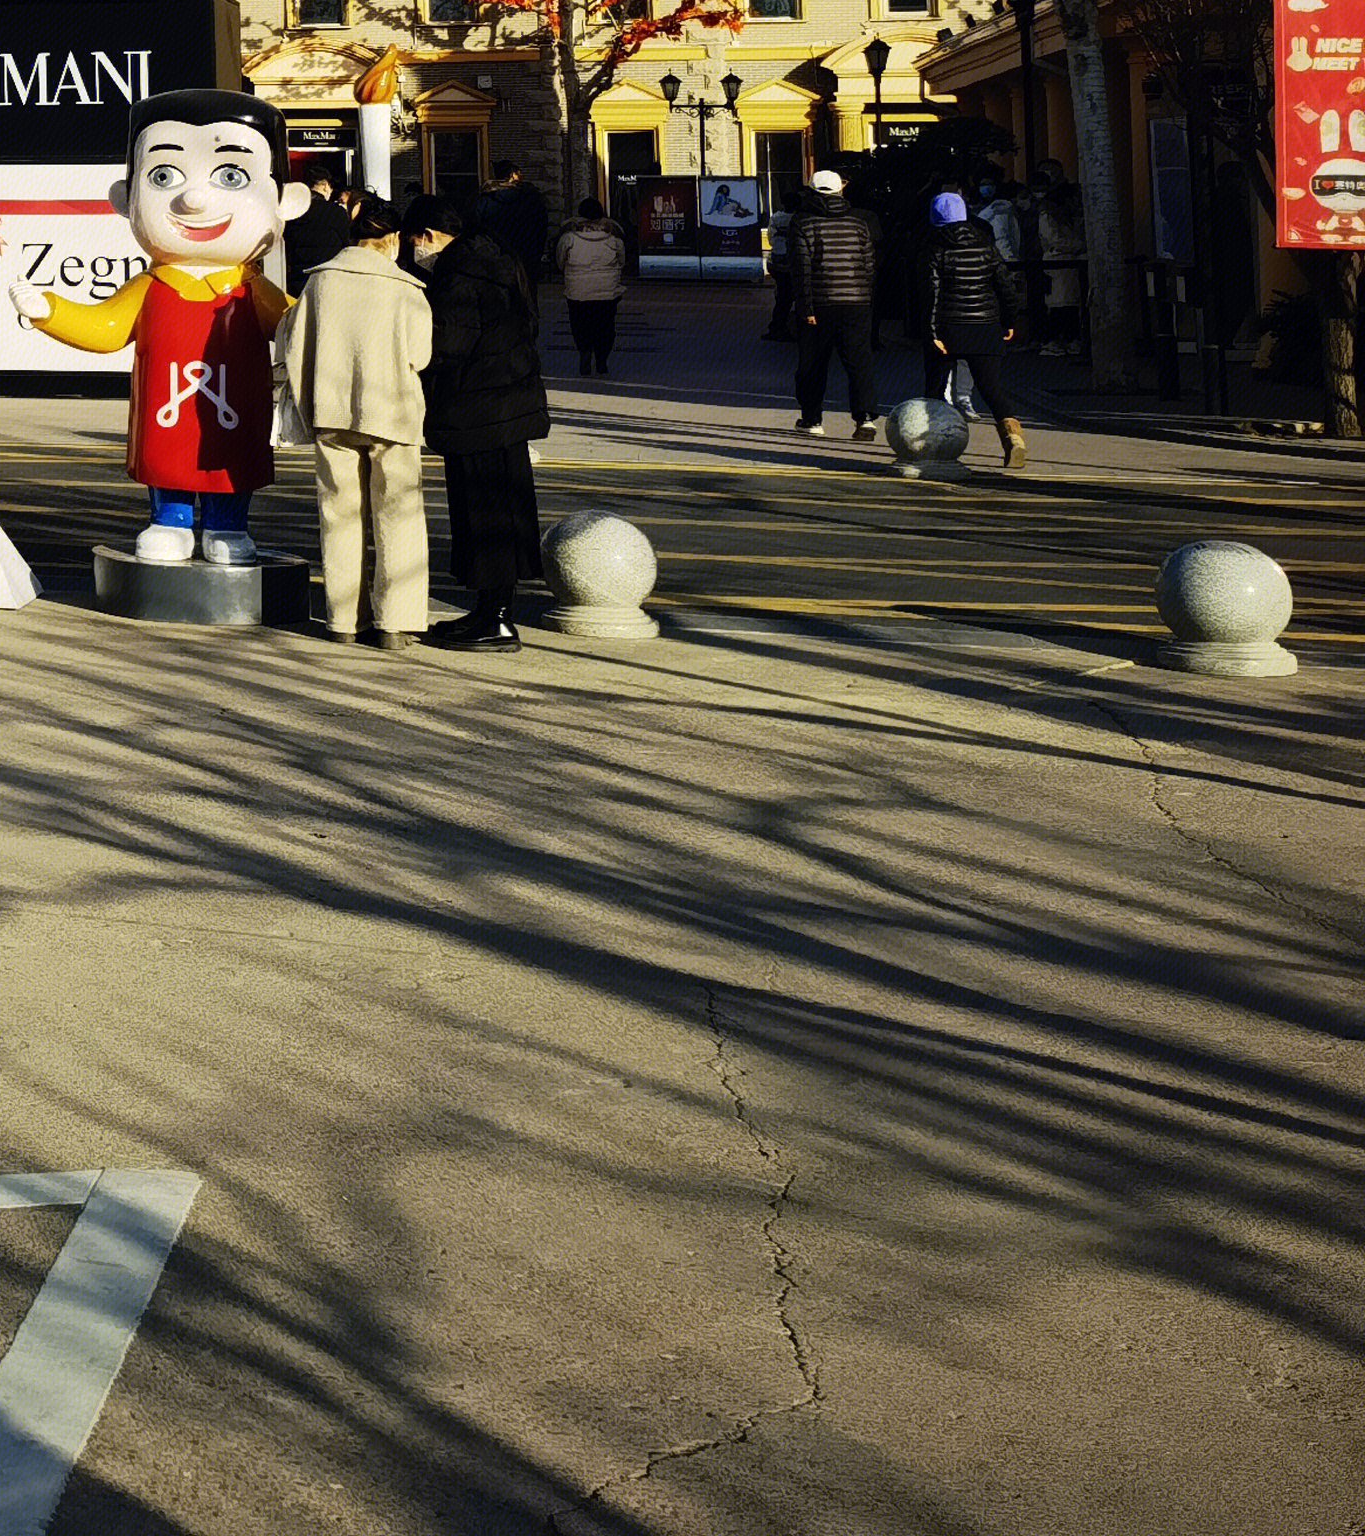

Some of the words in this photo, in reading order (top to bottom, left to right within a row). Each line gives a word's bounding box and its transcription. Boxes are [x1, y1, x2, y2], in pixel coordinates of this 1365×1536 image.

[1315, 37, 1364, 54] NICE
[1312, 56, 1361, 71] MEET
[21, 243, 149, 302] Zegn
